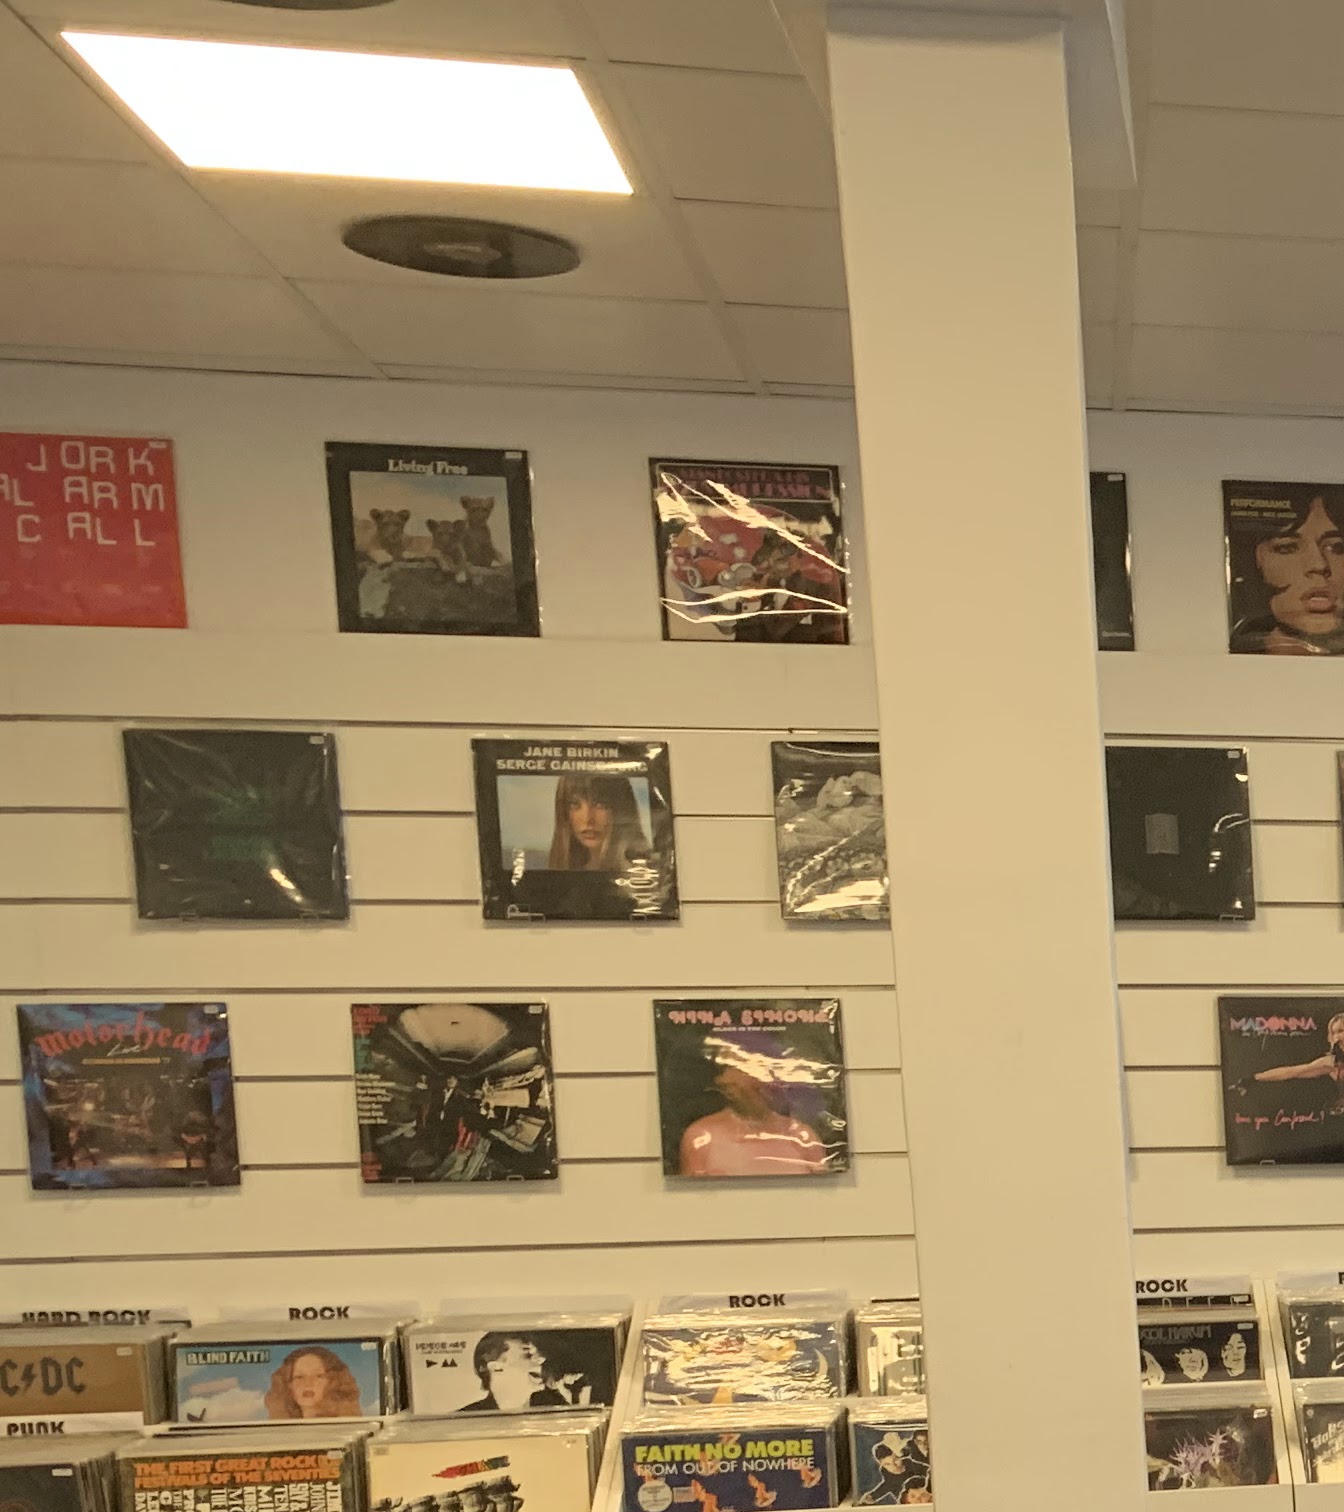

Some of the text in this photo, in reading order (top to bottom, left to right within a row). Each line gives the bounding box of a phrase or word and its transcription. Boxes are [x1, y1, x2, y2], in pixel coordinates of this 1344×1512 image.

[387, 458, 469, 476] Living Free
[523, 747, 620, 759] JANE BIRKIN
[496, 759, 649, 773] SERGE GAINSRG
[668, 1009, 831, 1026] NINA SIMONE
[1229, 1015, 1318, 1032] MADONNA
[1136, 1278, 1188, 1294] ROCK
[728, 1293, 786, 1308] ROCK
[288, 1305, 350, 1321] ROCK
[188, 1351, 270, 1366] BLIND FAITH
[7, 1421, 65, 1437] PUNK
[635, 1439, 814, 1464] FAITH NO MORE
[135, 1462, 165, 1476] THE
[169, 1460, 213, 1474] FIRST
[215, 1457, 268, 1472] GREAT
[270, 1455, 316, 1470] ROCK
[636, 1462, 678, 1476] FROM
[718, 1460, 739, 1473] OF
[741, 1457, 815, 1472] NOWHERE
[210, 1472, 231, 1484] OF
[234, 1471, 262, 1483] THE
